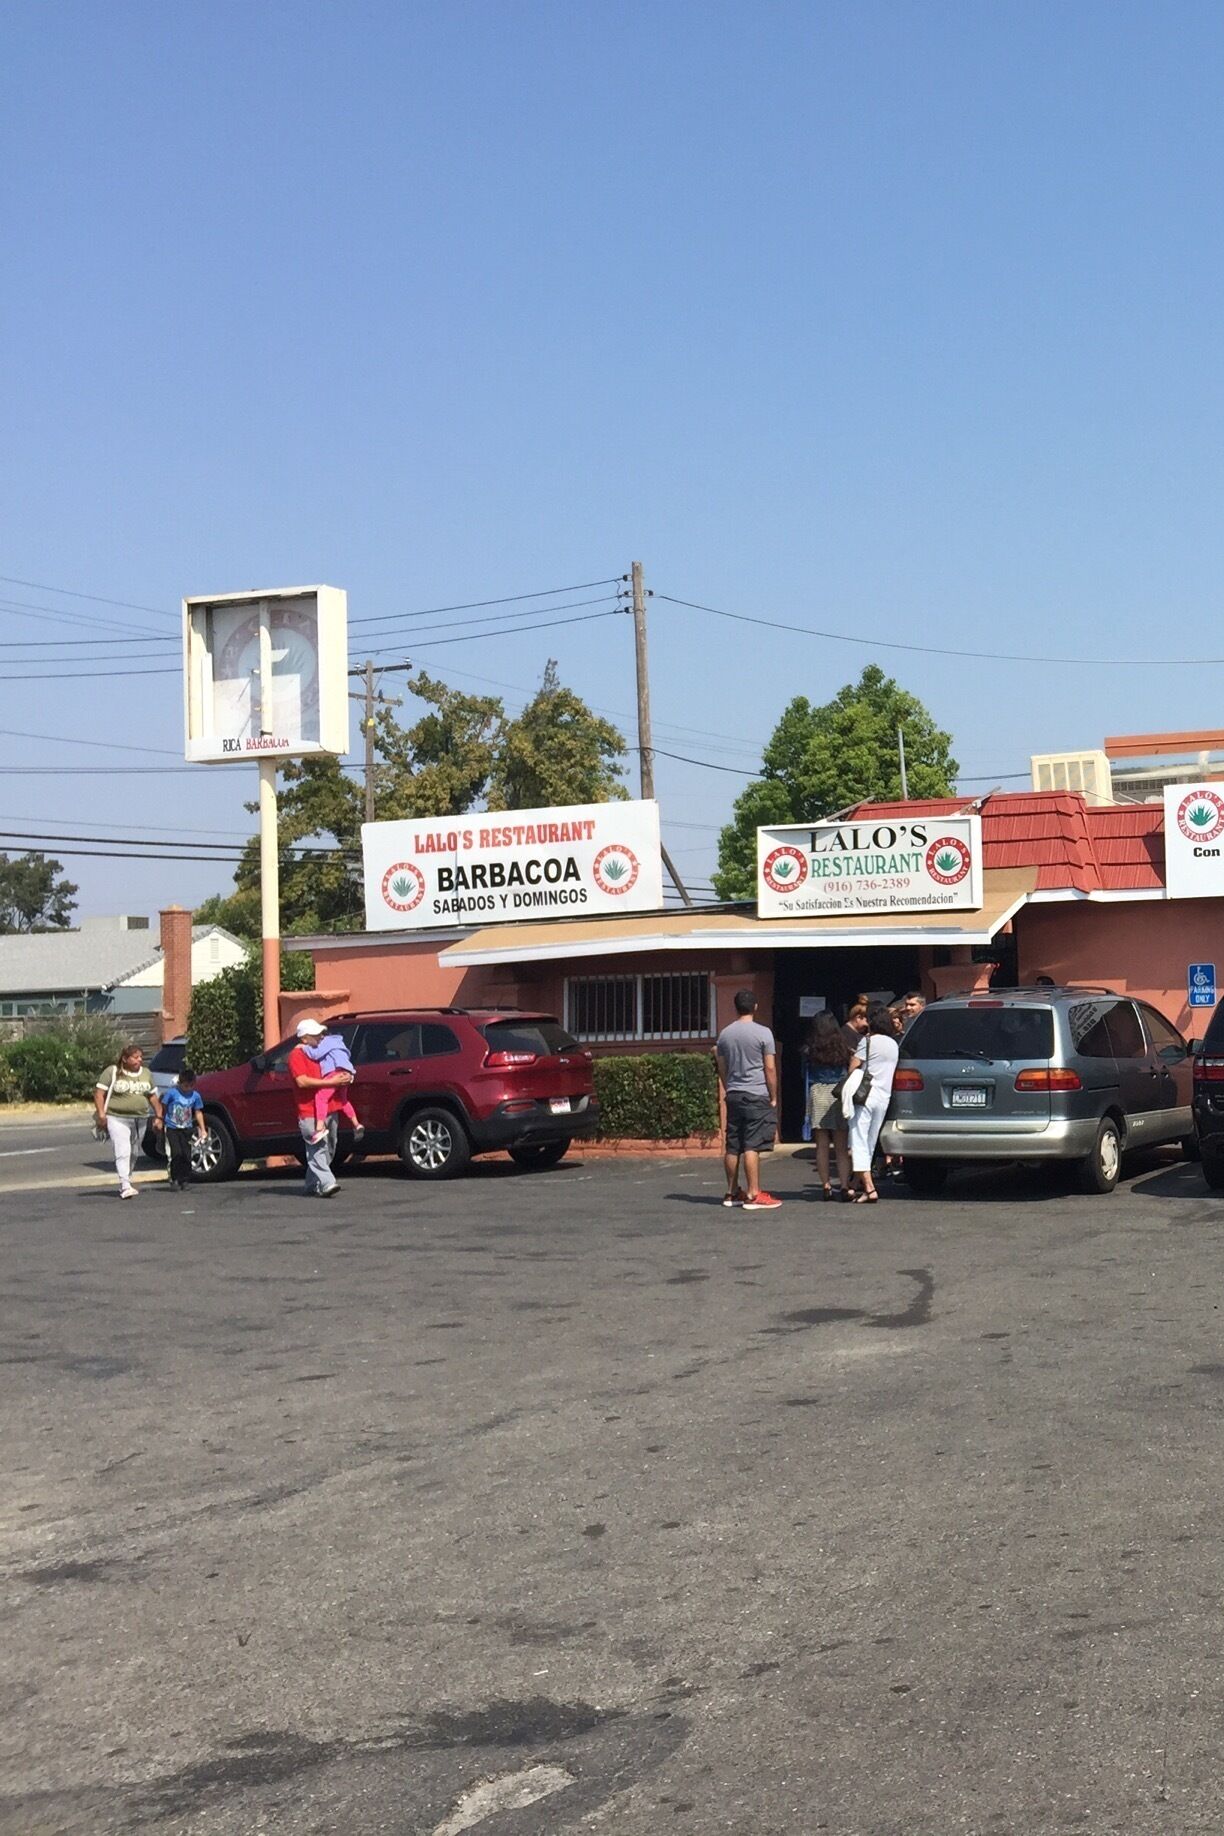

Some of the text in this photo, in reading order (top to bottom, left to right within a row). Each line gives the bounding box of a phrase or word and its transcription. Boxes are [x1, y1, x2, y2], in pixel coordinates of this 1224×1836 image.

[223, 738, 241, 752] RICA
[414, 820, 596, 854] LALO'S RESTAURANT
[809, 825, 928, 853] LALO'S
[1193, 846, 1220, 858] Con
[437, 856, 582, 893] BARBACOA
[811, 853, 923, 878] RESTAURANT
[823, 877, 911, 894] (916) 736-2389
[433, 887, 588, 915] SABADOS Y DOMINGOS
[796, 897, 842, 911] Satisfaccion
[857, 896, 888, 907] Nuestra
[1195, 994, 1210, 1003] ONLY
